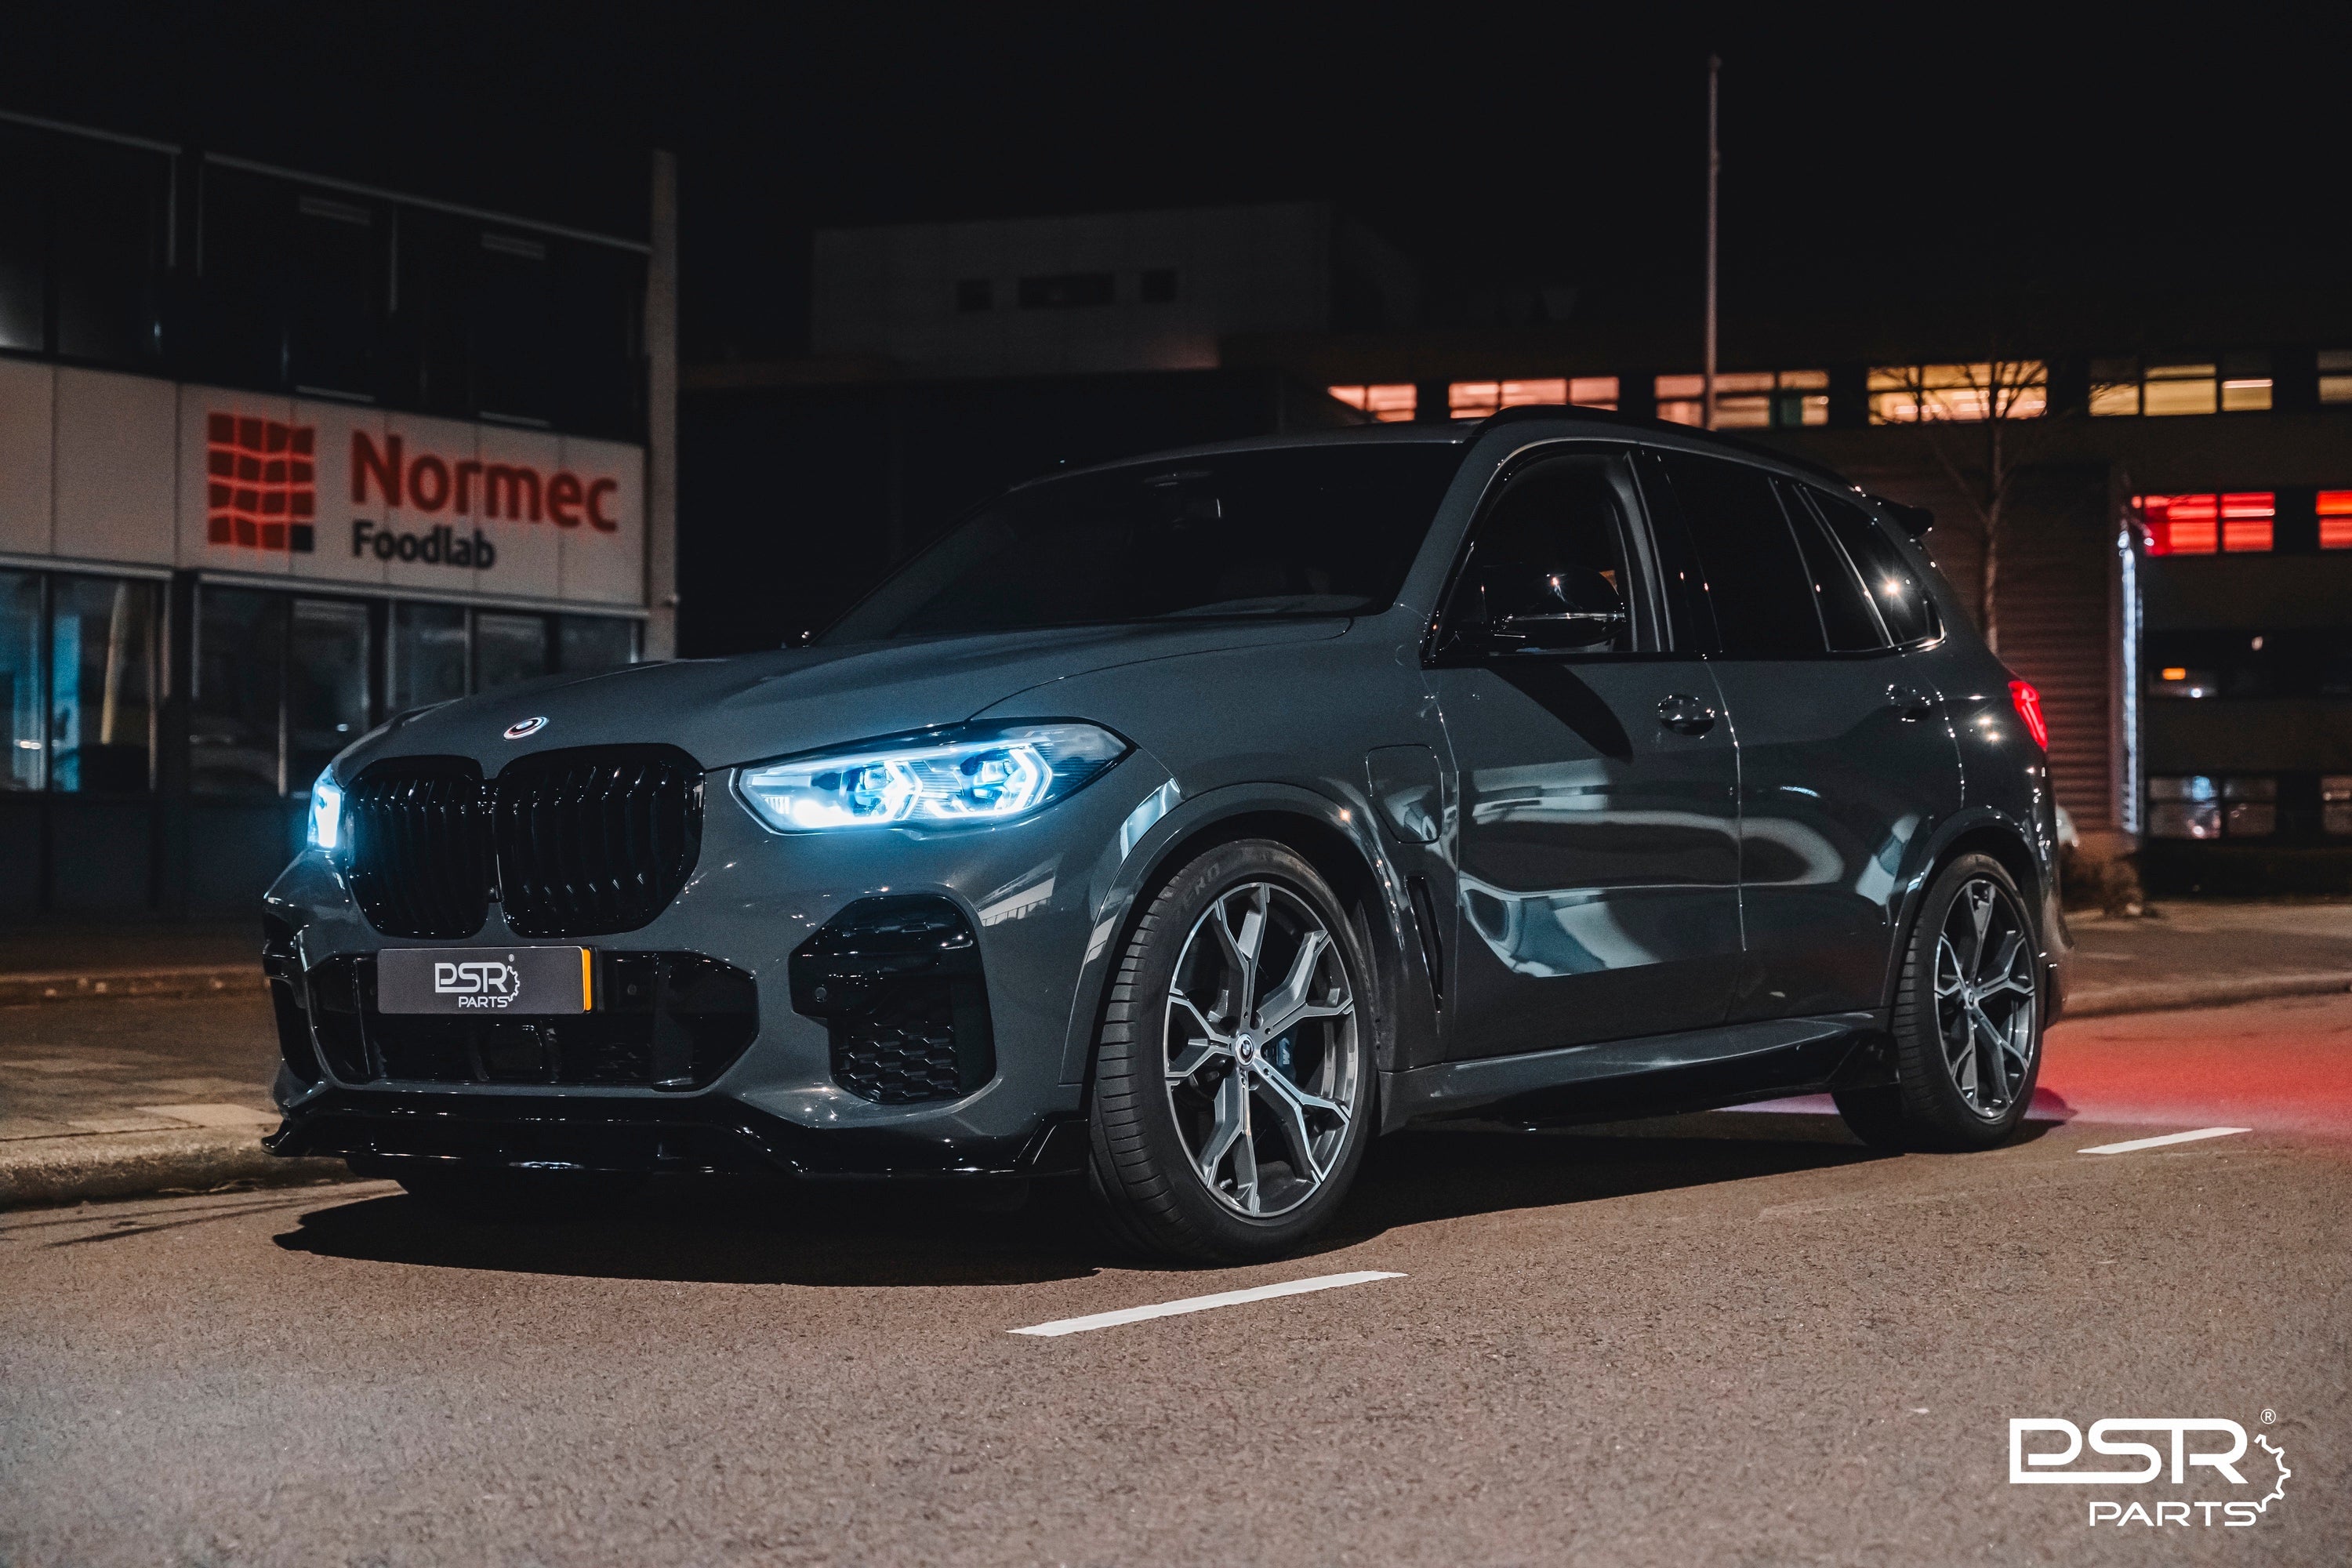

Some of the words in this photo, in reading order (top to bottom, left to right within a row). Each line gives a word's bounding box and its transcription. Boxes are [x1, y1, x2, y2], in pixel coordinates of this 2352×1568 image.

[352, 430, 618, 533] Normec
[353, 520, 495, 569] Foodlab
[434, 962, 508, 993] PSR
[458, 996, 509, 1008] PARTS
